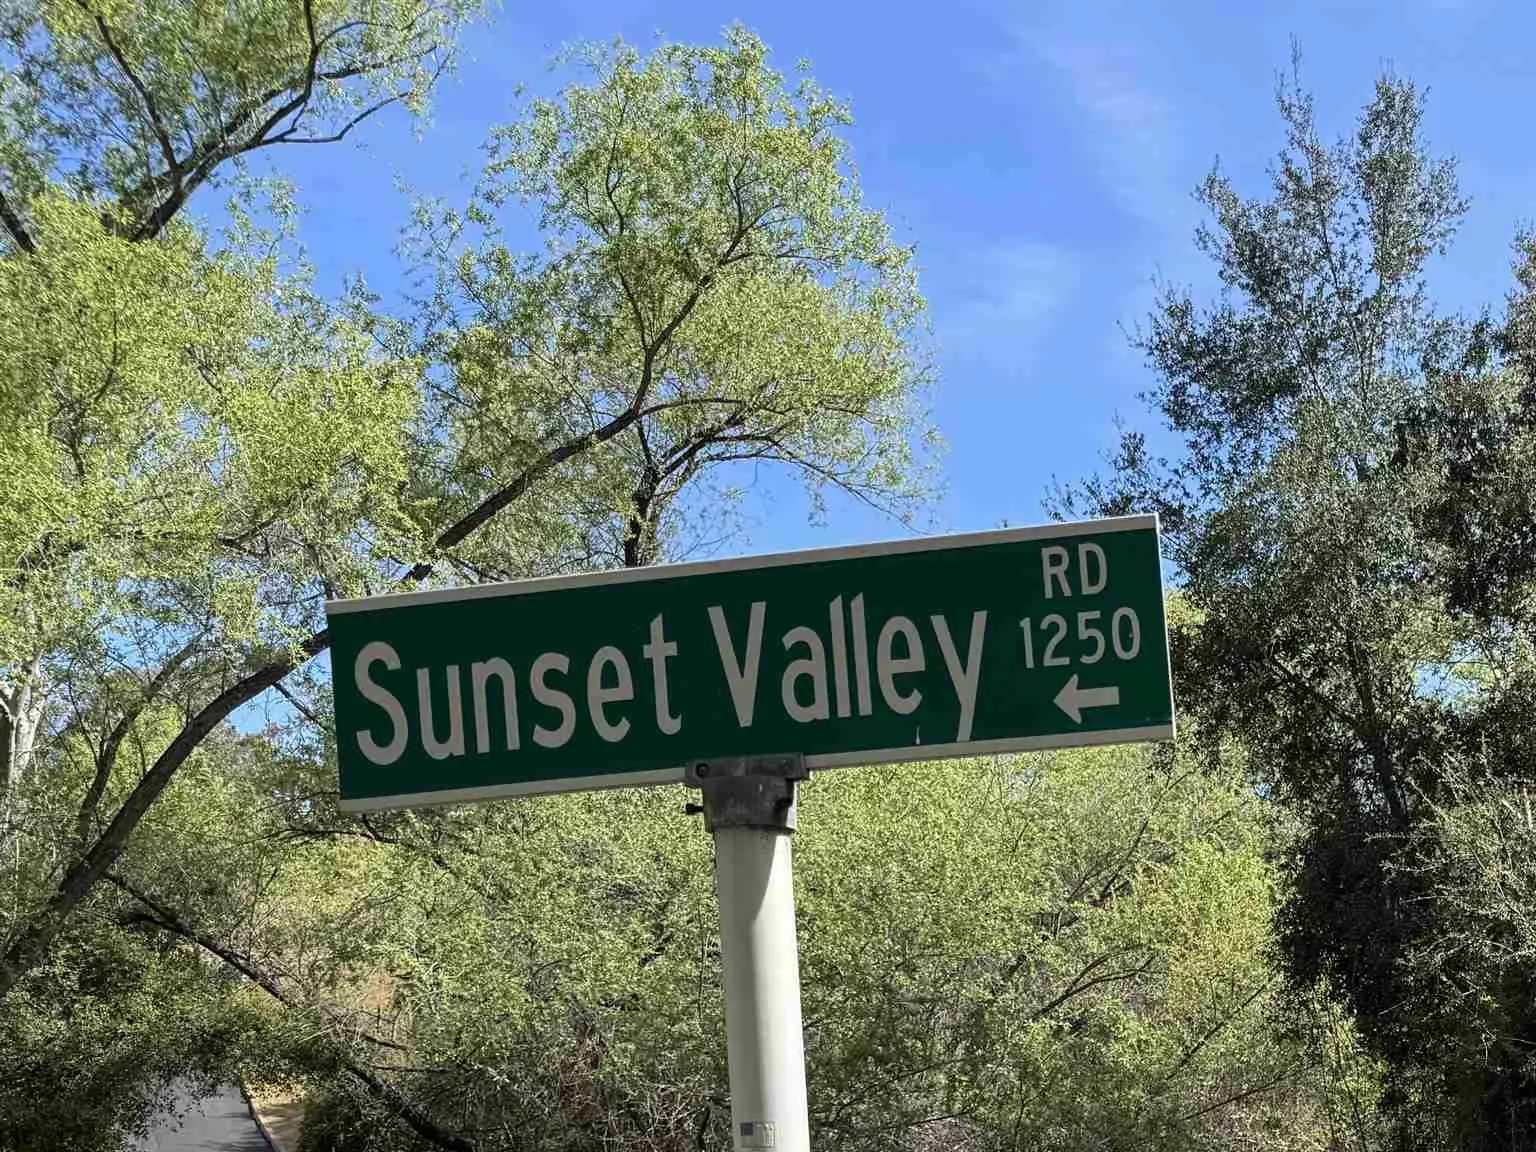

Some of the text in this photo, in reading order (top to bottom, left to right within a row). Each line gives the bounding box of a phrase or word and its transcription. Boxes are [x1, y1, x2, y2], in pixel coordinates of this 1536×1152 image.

[1042, 542, 1108, 599] RD
[1019, 605, 1142, 670] 1250
[353, 593, 989, 766] Sunset Valley
